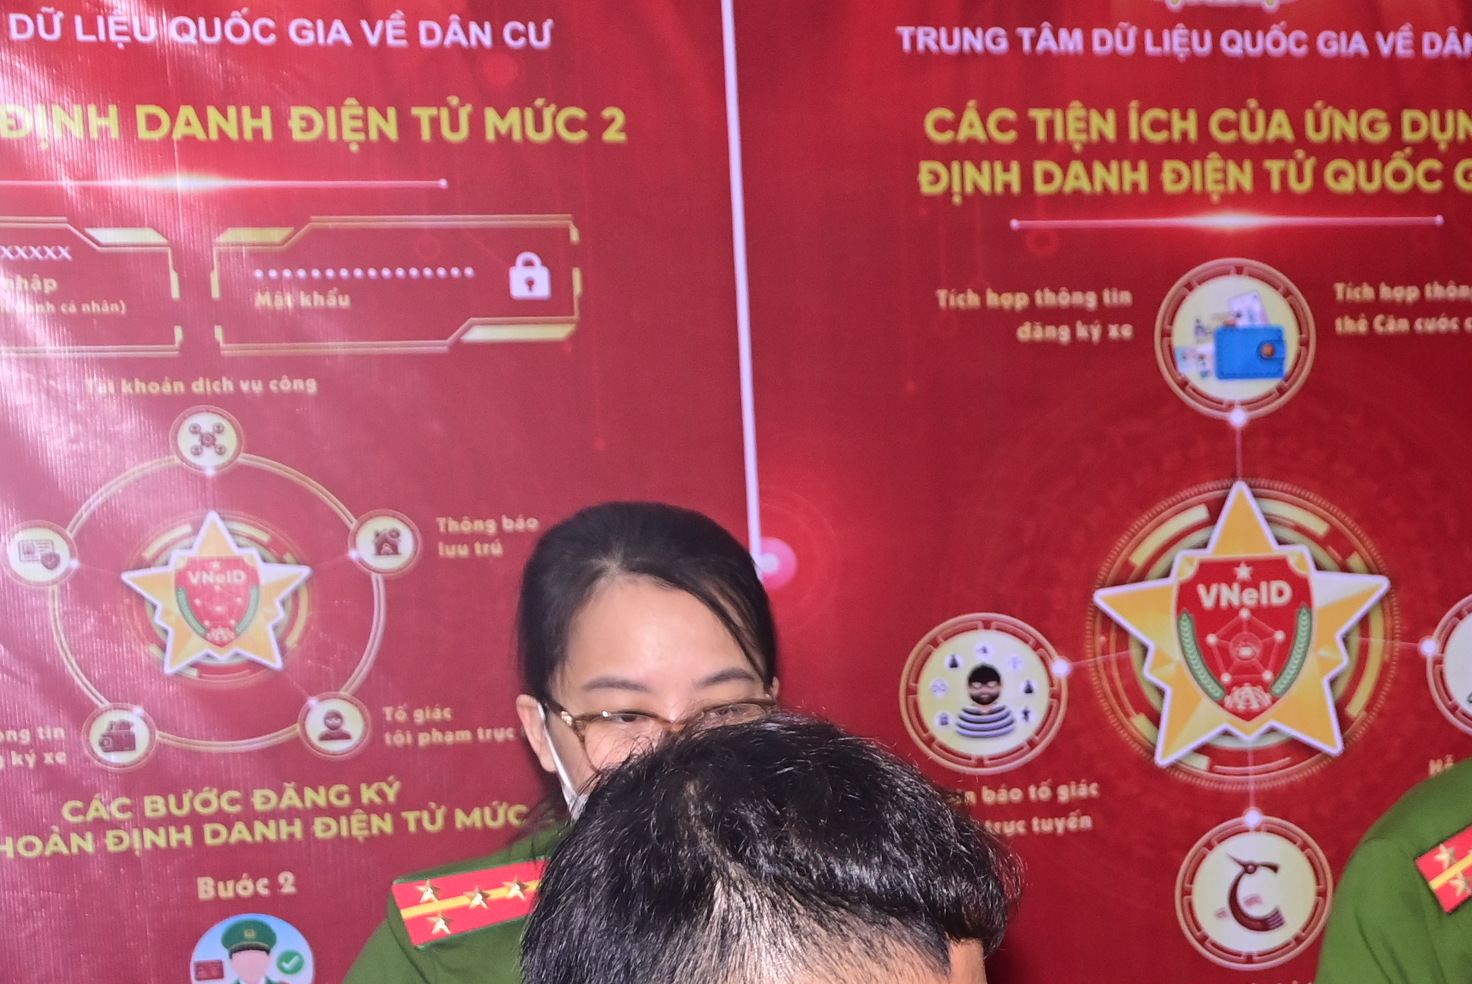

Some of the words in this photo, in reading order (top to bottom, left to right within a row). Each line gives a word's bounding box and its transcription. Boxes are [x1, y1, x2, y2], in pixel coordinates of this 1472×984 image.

[9, 8, 64, 41] DỮ
[75, 16, 156, 49] LIỆU
[172, 14, 276, 47] QUỐC
[288, 18, 352, 46] GIA
[361, 10, 408, 47] VỀ
[419, 14, 493, 48] DÂN
[503, 19, 553, 49] CƯ
[896, 26, 1009, 54] TRUNG
[1017, 22, 1084, 54] TÂM
[1092, 22, 1137, 55] DỮ
[1145, 23, 1212, 61] LIỆU
[1220, 21, 1308, 57] QUỐC
[1317, 30, 1369, 57] GIA
[1376, 23, 1414, 58] VỀ
[0, 104, 119, 151] ĐỊNH
[136, 105, 273, 141] DANH
[288, 98, 399, 152] ĐIỆN
[411, 96, 473, 142] TỬ
[485, 98, 588, 143] MỨC
[602, 107, 627, 142] 2
[925, 100, 1017, 143] CÁC
[1028, 101, 1116, 152] TIỆN
[1129, 100, 1198, 143] ÍCH
[1209, 99, 1294, 143] CỦA
[1305, 101, 1391, 142] ỨNG
[918, 161, 1021, 204] ĐỊNH
[1034, 161, 1148, 194] DANH
[1161, 152, 1253, 202] ĐIỆN
[1264, 150, 1316, 193] TỬ
[1324, 148, 1443, 193] QUỐC
[936, 289, 980, 309] Tích
[1035, 287, 1097, 311] thông
[1103, 288, 1132, 306] tin
[1334, 283, 1375, 302] Tích
[1076, 321, 1102, 343] ký
[1108, 324, 1133, 339] xe
[191, 376, 234, 395] dịch
[239, 380, 263, 394] vụ
[269, 375, 317, 395] công
[436, 517, 497, 536] Thông
[502, 515, 539, 532] báo
[188, 569, 247, 586] VNeID
[1197, 580, 1292, 609] VNeID
[382, 704, 408, 723] Tố
[413, 707, 452, 725] giác
[37, 725, 66, 740] tin
[44, 751, 67, 764] xe
[62, 791, 133, 823] CÁC
[144, 787, 242, 818] BƯỚC
[251, 783, 351, 811] ĐĂNG
[360, 780, 401, 805] KÝ
[982, 785, 1023, 804] báo
[1028, 779, 1052, 801] tố
[1057, 779, 1098, 803] giác
[104, 825, 193, 856] ĐỊNH
[204, 819, 303, 845] DANH
[312, 809, 399, 841] ĐIỆN
[401, 802, 447, 833] TỬ
[1031, 810, 1092, 835] tuyến
[197, 873, 270, 900] Bước
[278, 871, 296, 894] 2
